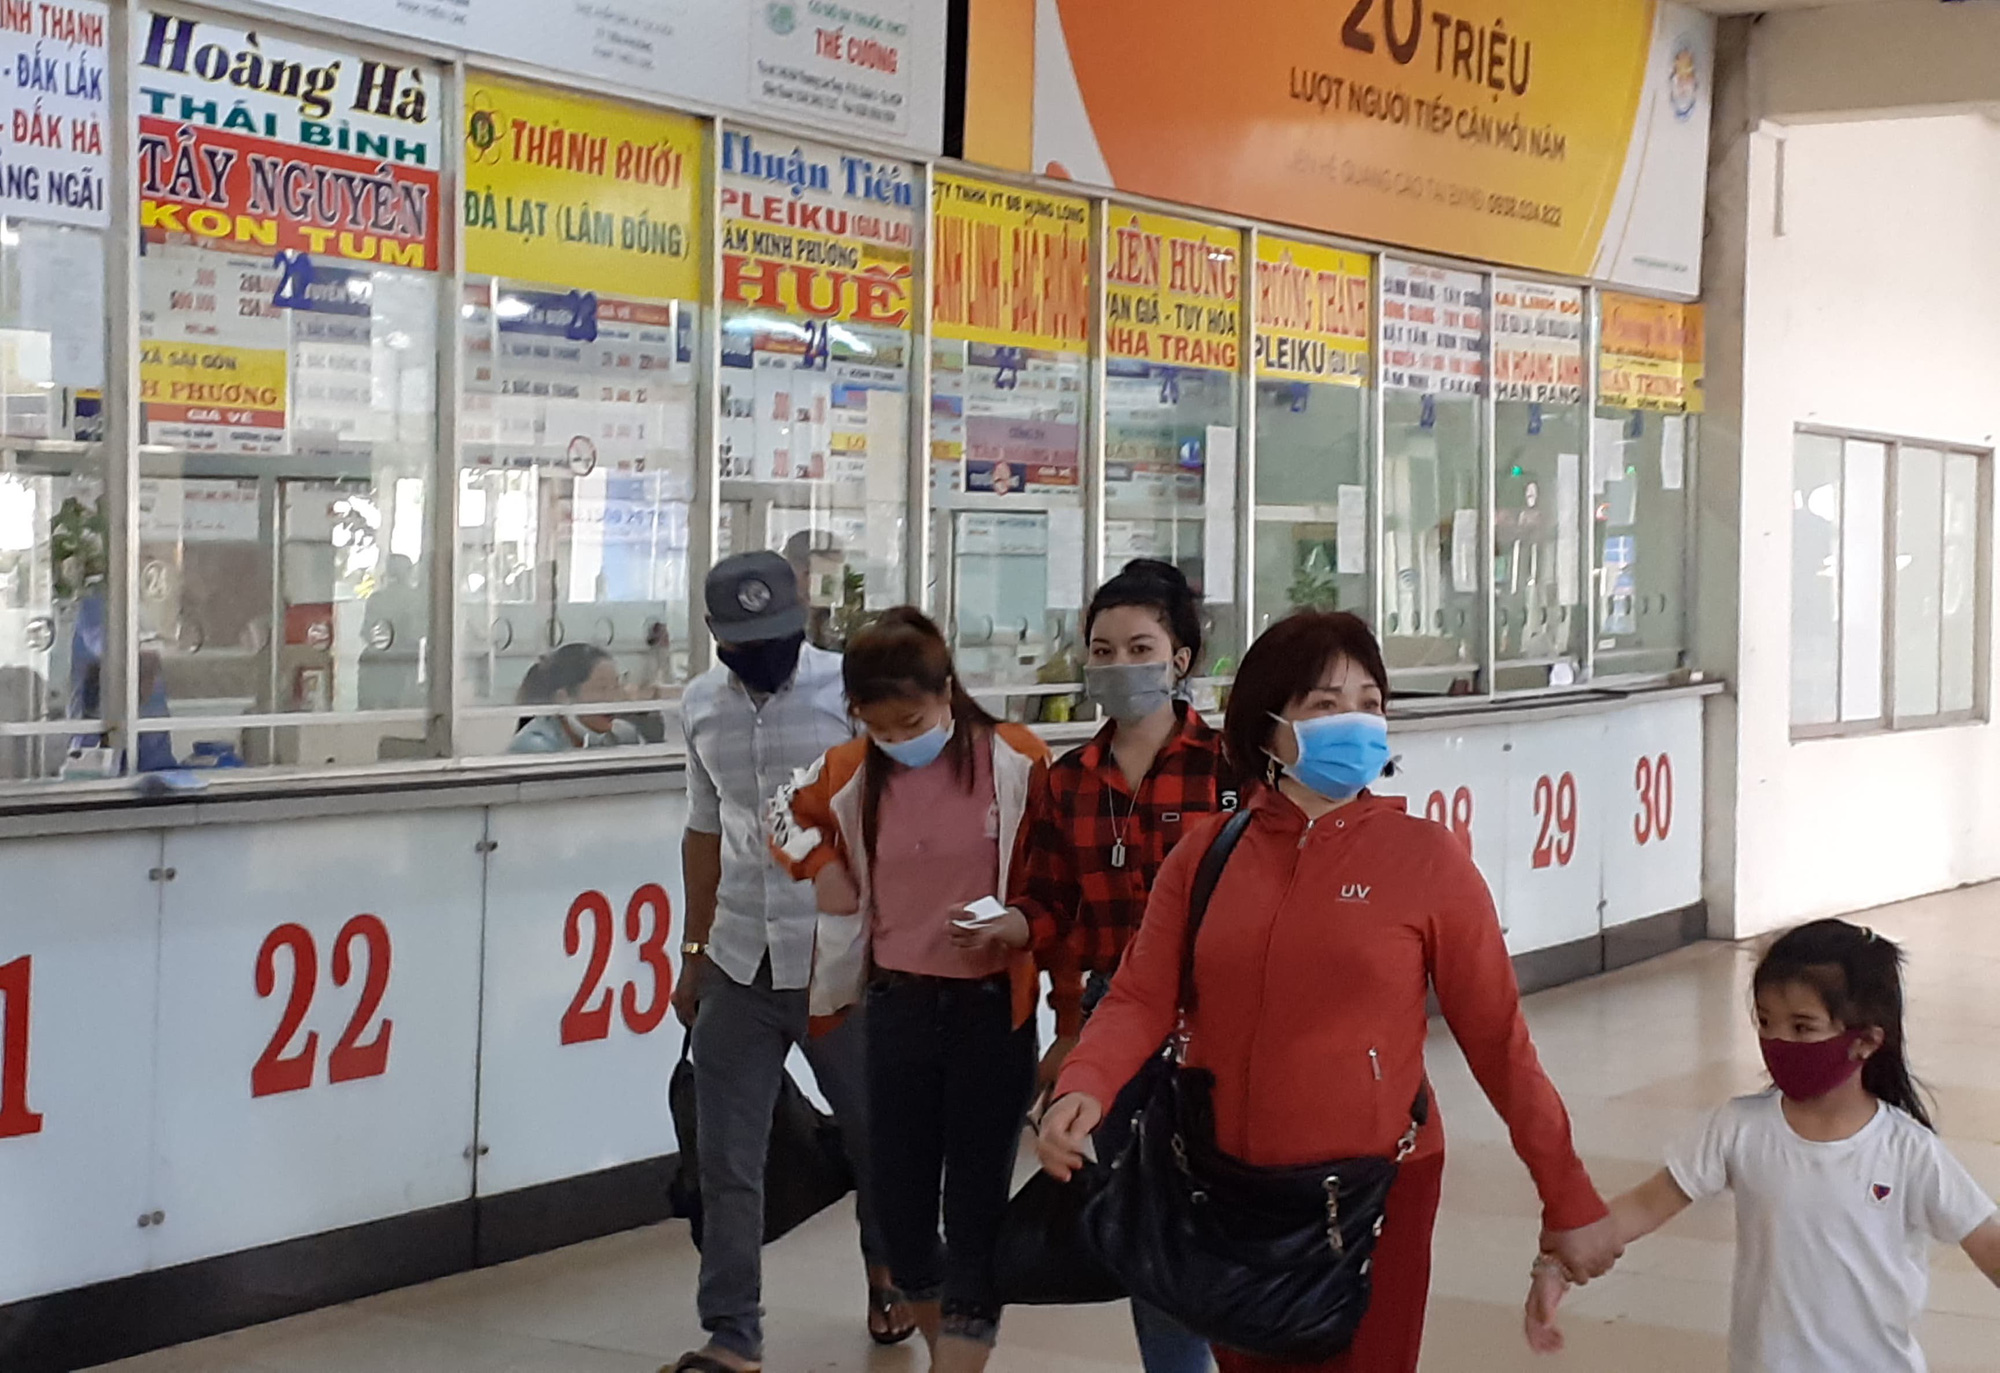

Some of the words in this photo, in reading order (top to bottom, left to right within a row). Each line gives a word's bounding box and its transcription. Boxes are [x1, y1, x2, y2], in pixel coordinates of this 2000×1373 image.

[39, 4, 103, 50] THẠNH
[140, 13, 342, 119] Hoàng
[350, 59, 428, 124] Hà
[1432, 12, 1531, 103] TRIỆU
[140, 87, 277, 137] THÁI
[300, 119, 427, 165] BÌNH
[48, 166, 103, 211] NGÃI
[723, 132, 831, 200] Thuận
[140, 200, 278, 246] KON
[299, 226, 425, 268] TUM
[507, 196, 548, 243] LẠT
[722, 188, 847, 234] PLEIKU
[753, 230, 792, 259] MINH
[722, 254, 912, 326] HUẾ
[1175, 303, 1202, 332] TUY
[804, 320, 829, 371] 24
[1158, 333, 1237, 368] TRANG
[1256, 335, 1325, 374] PLEIKU
[171, 379, 277, 406] PHƯƠNG
[1532, 771, 1579, 869] 29
[1635, 752, 1673, 846] 30
[1341, 884, 1371, 899] UV
[560, 883, 674, 1046] 23
[251, 914, 393, 1098] 22
